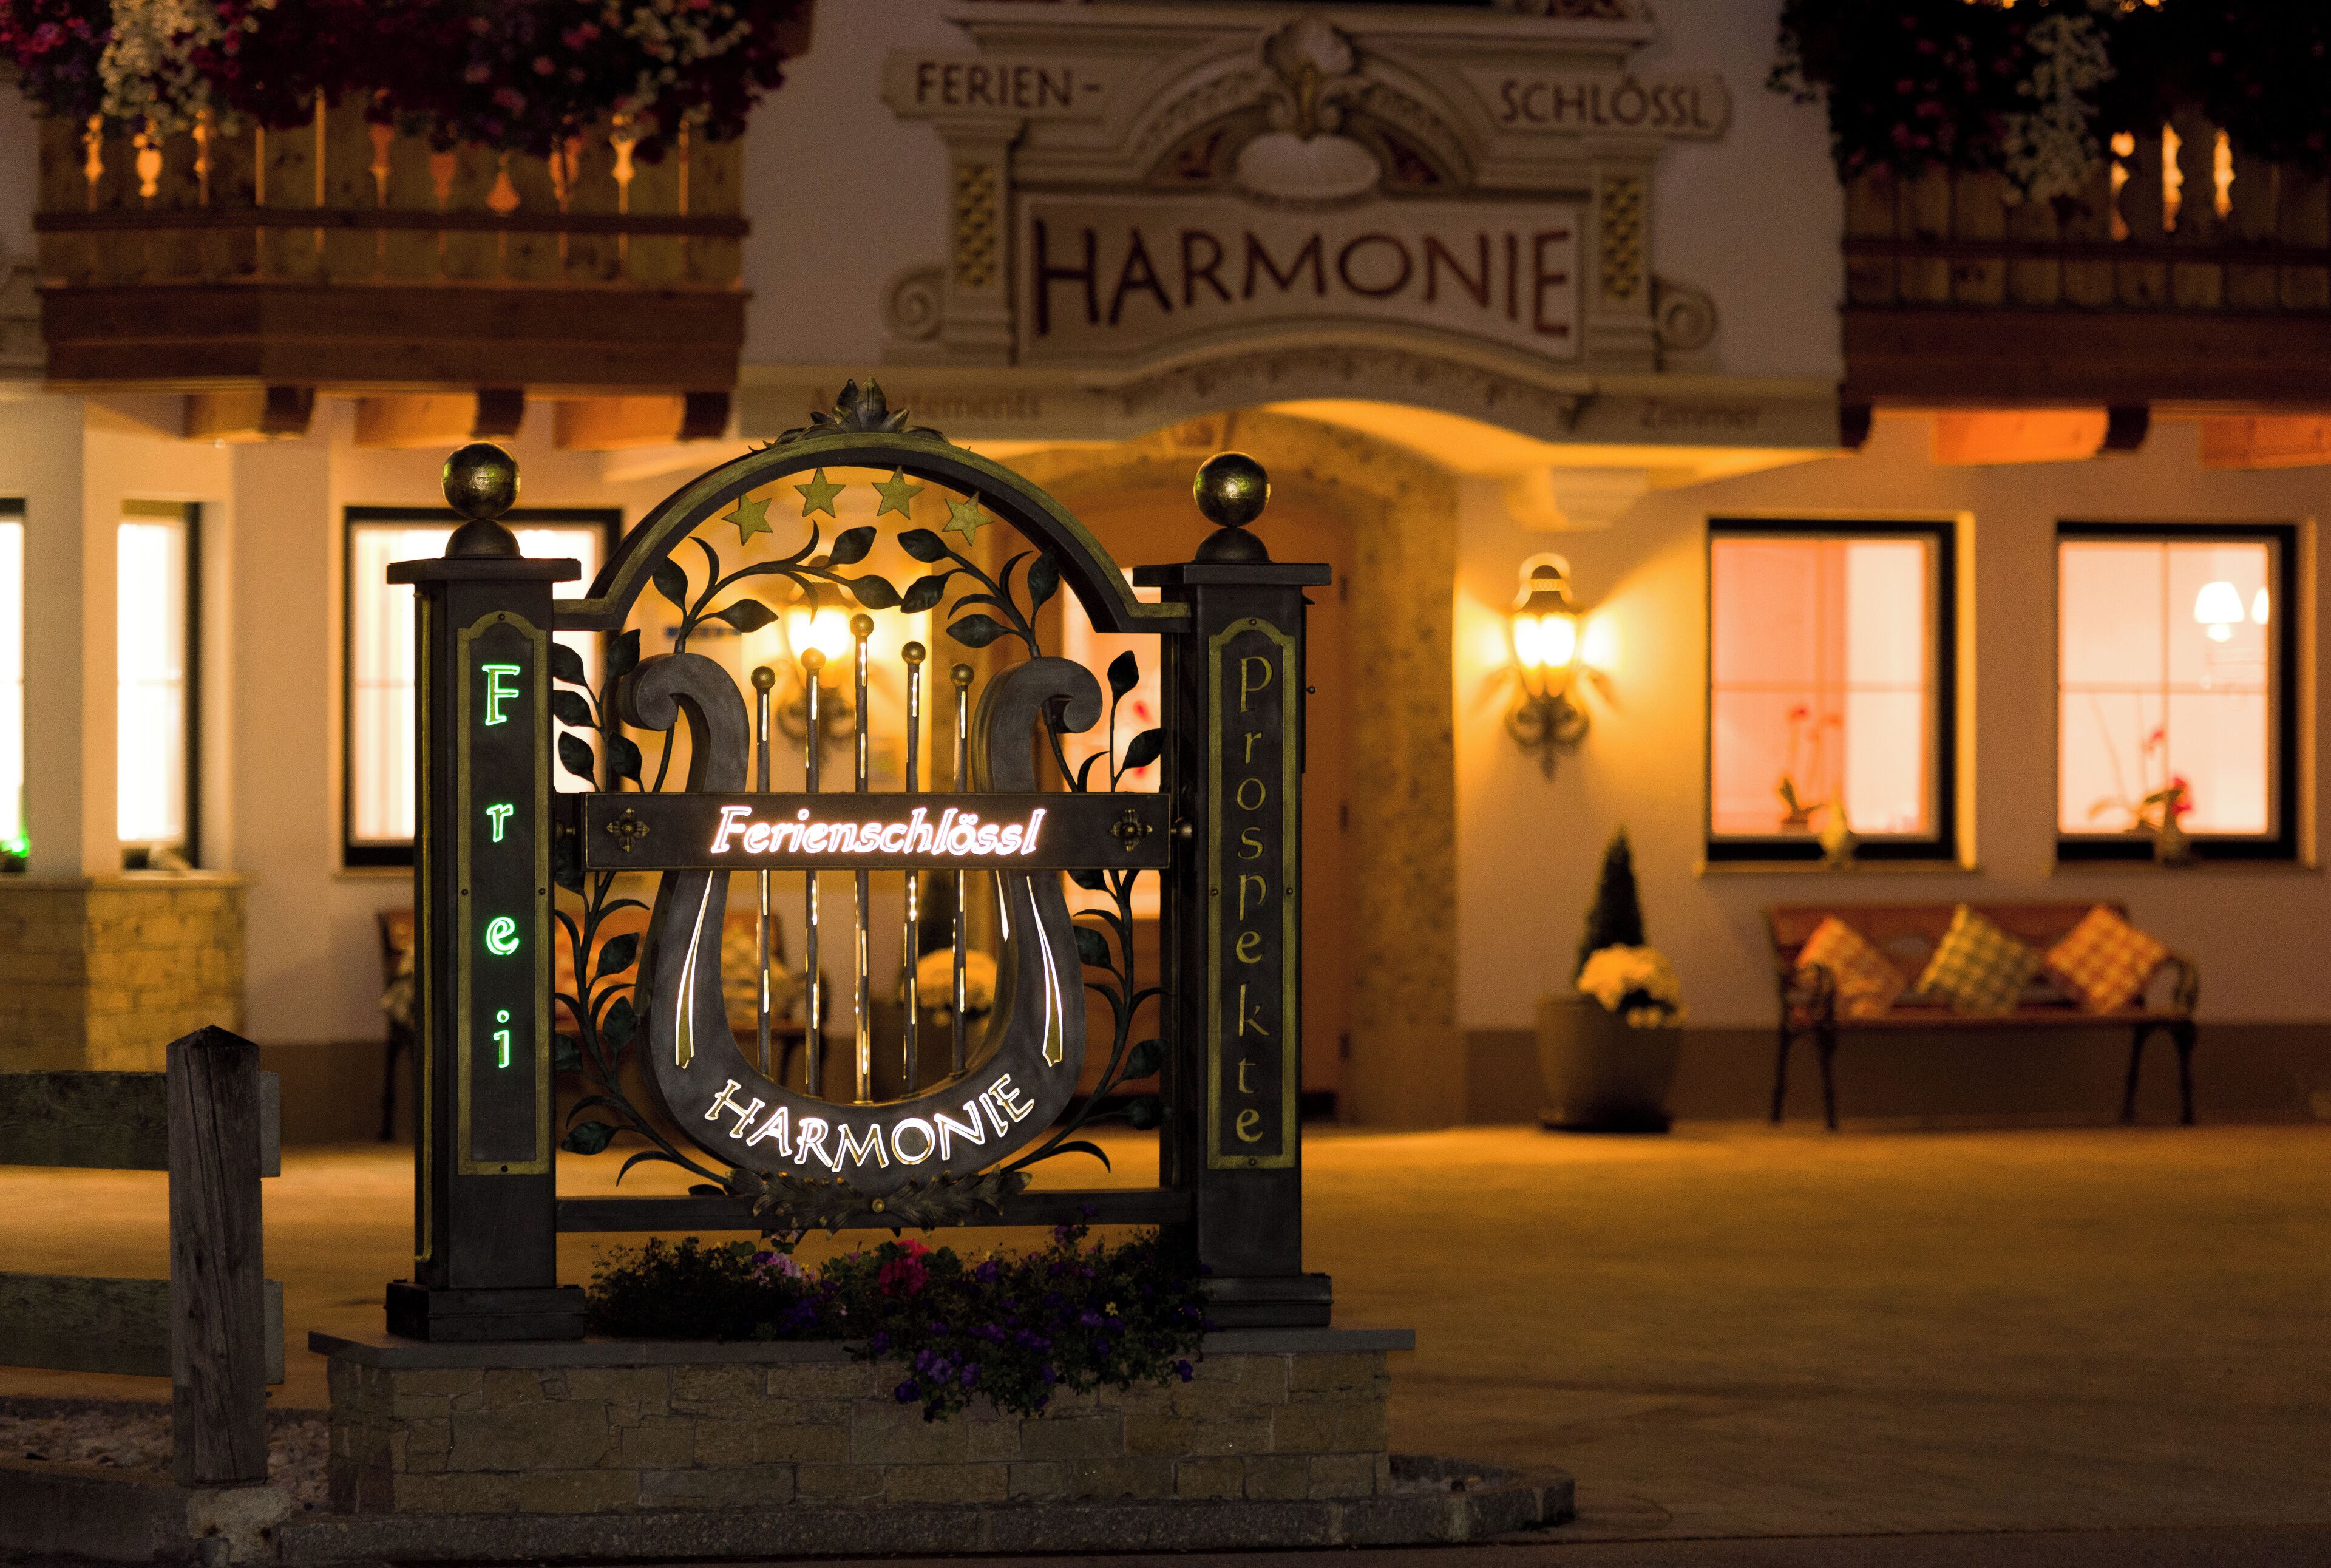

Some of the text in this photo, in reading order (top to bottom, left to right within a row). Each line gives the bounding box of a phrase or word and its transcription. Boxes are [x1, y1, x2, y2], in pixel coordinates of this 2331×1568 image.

[916, 61, 1711, 127] FERIEN- SCHLÖSSL
[1034, 219, 1571, 336] HARMONIE
[482, 664, 521, 1070] Frei
[710, 806, 1047, 857] Ferienschlössl
[1235, 654, 1275, 1144] Prospekte
[704, 1073, 1035, 1173] HARMONIE
